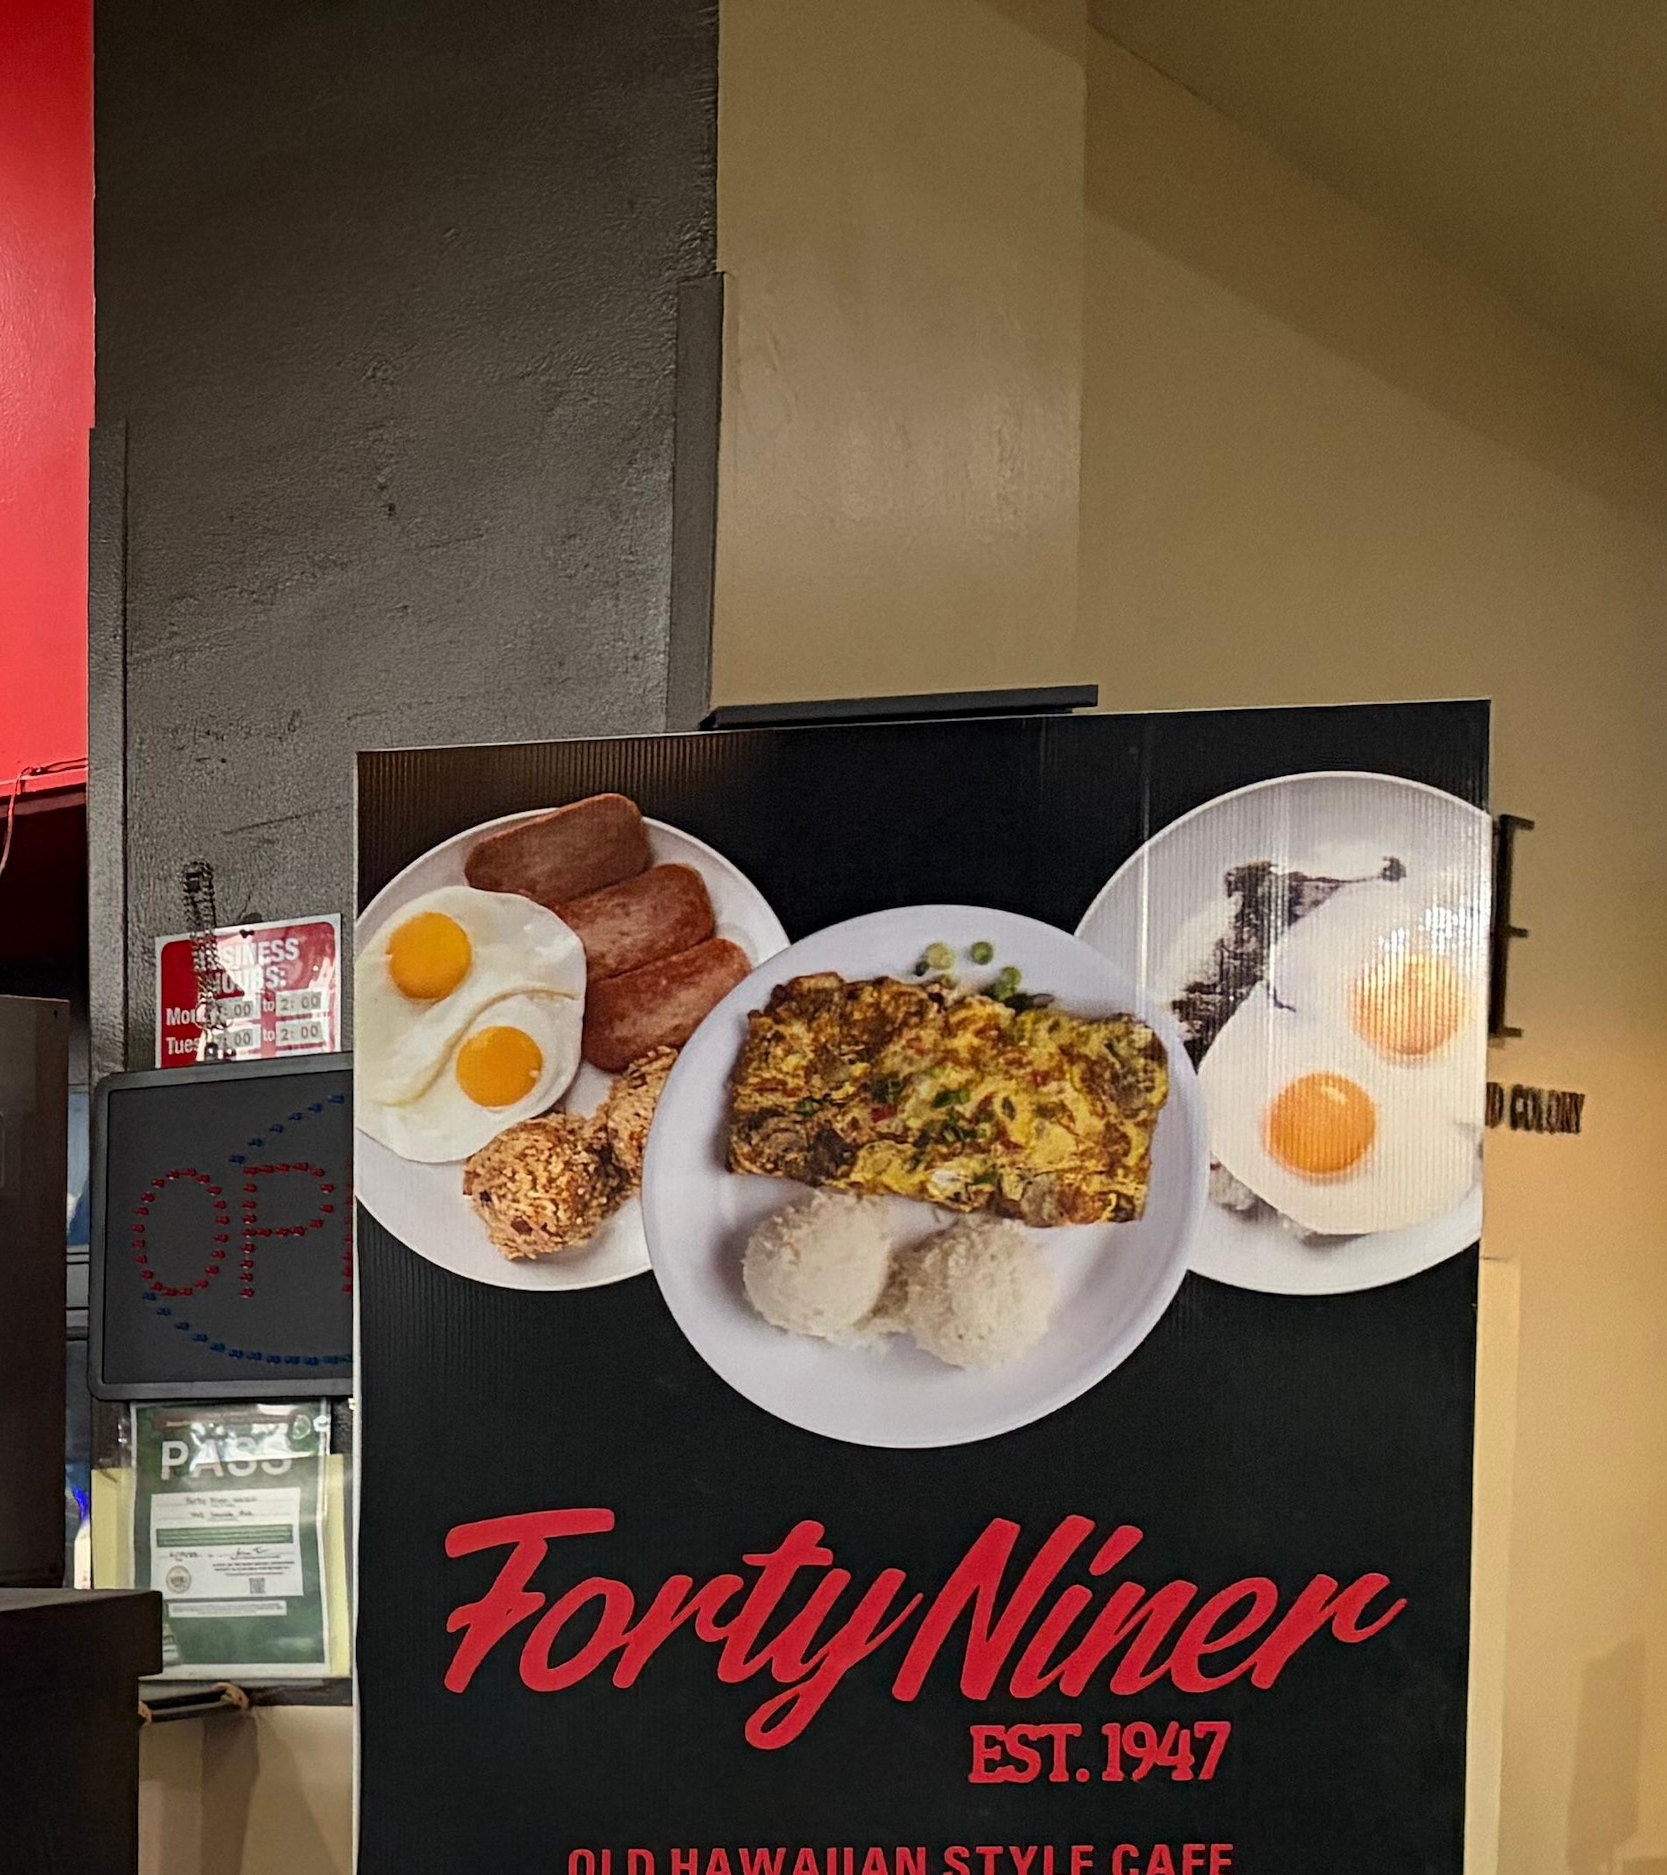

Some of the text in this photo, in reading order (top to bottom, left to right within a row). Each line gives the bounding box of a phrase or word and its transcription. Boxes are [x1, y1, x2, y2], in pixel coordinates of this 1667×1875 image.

[194, 938, 299, 972] SINESS
[263, 1030, 275, 1041] to
[133, 1161, 353, 1300] OP
[161, 1436, 292, 1480] PASS
[443, 1507, 1407, 1750] Forty Niner
[968, 1719, 1231, 1784] EST. 1947
